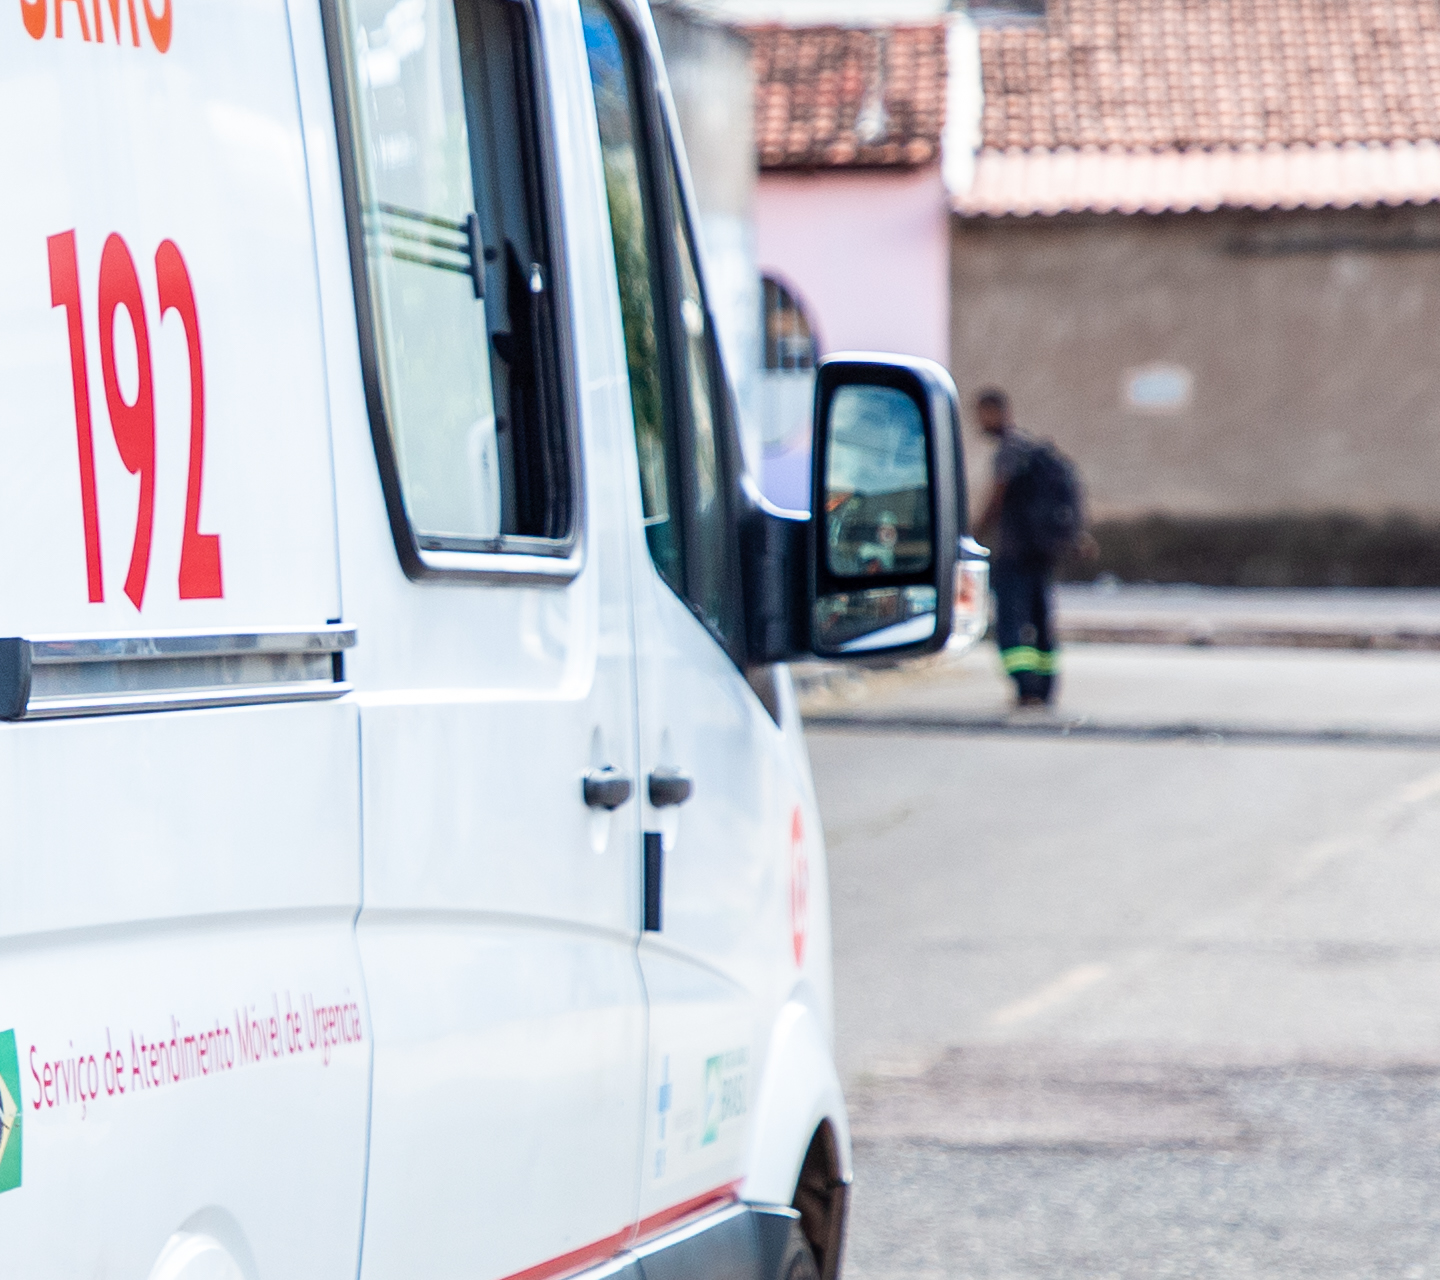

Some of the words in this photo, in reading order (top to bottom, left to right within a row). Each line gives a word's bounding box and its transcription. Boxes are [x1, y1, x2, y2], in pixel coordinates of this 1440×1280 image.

[46, 228, 225, 613] 192
[29, 1039, 99, 1121] Serviço
[103, 1026, 125, 1096] de
[130, 1014, 235, 1092] Atendimento
[284, 989, 304, 1054] de
